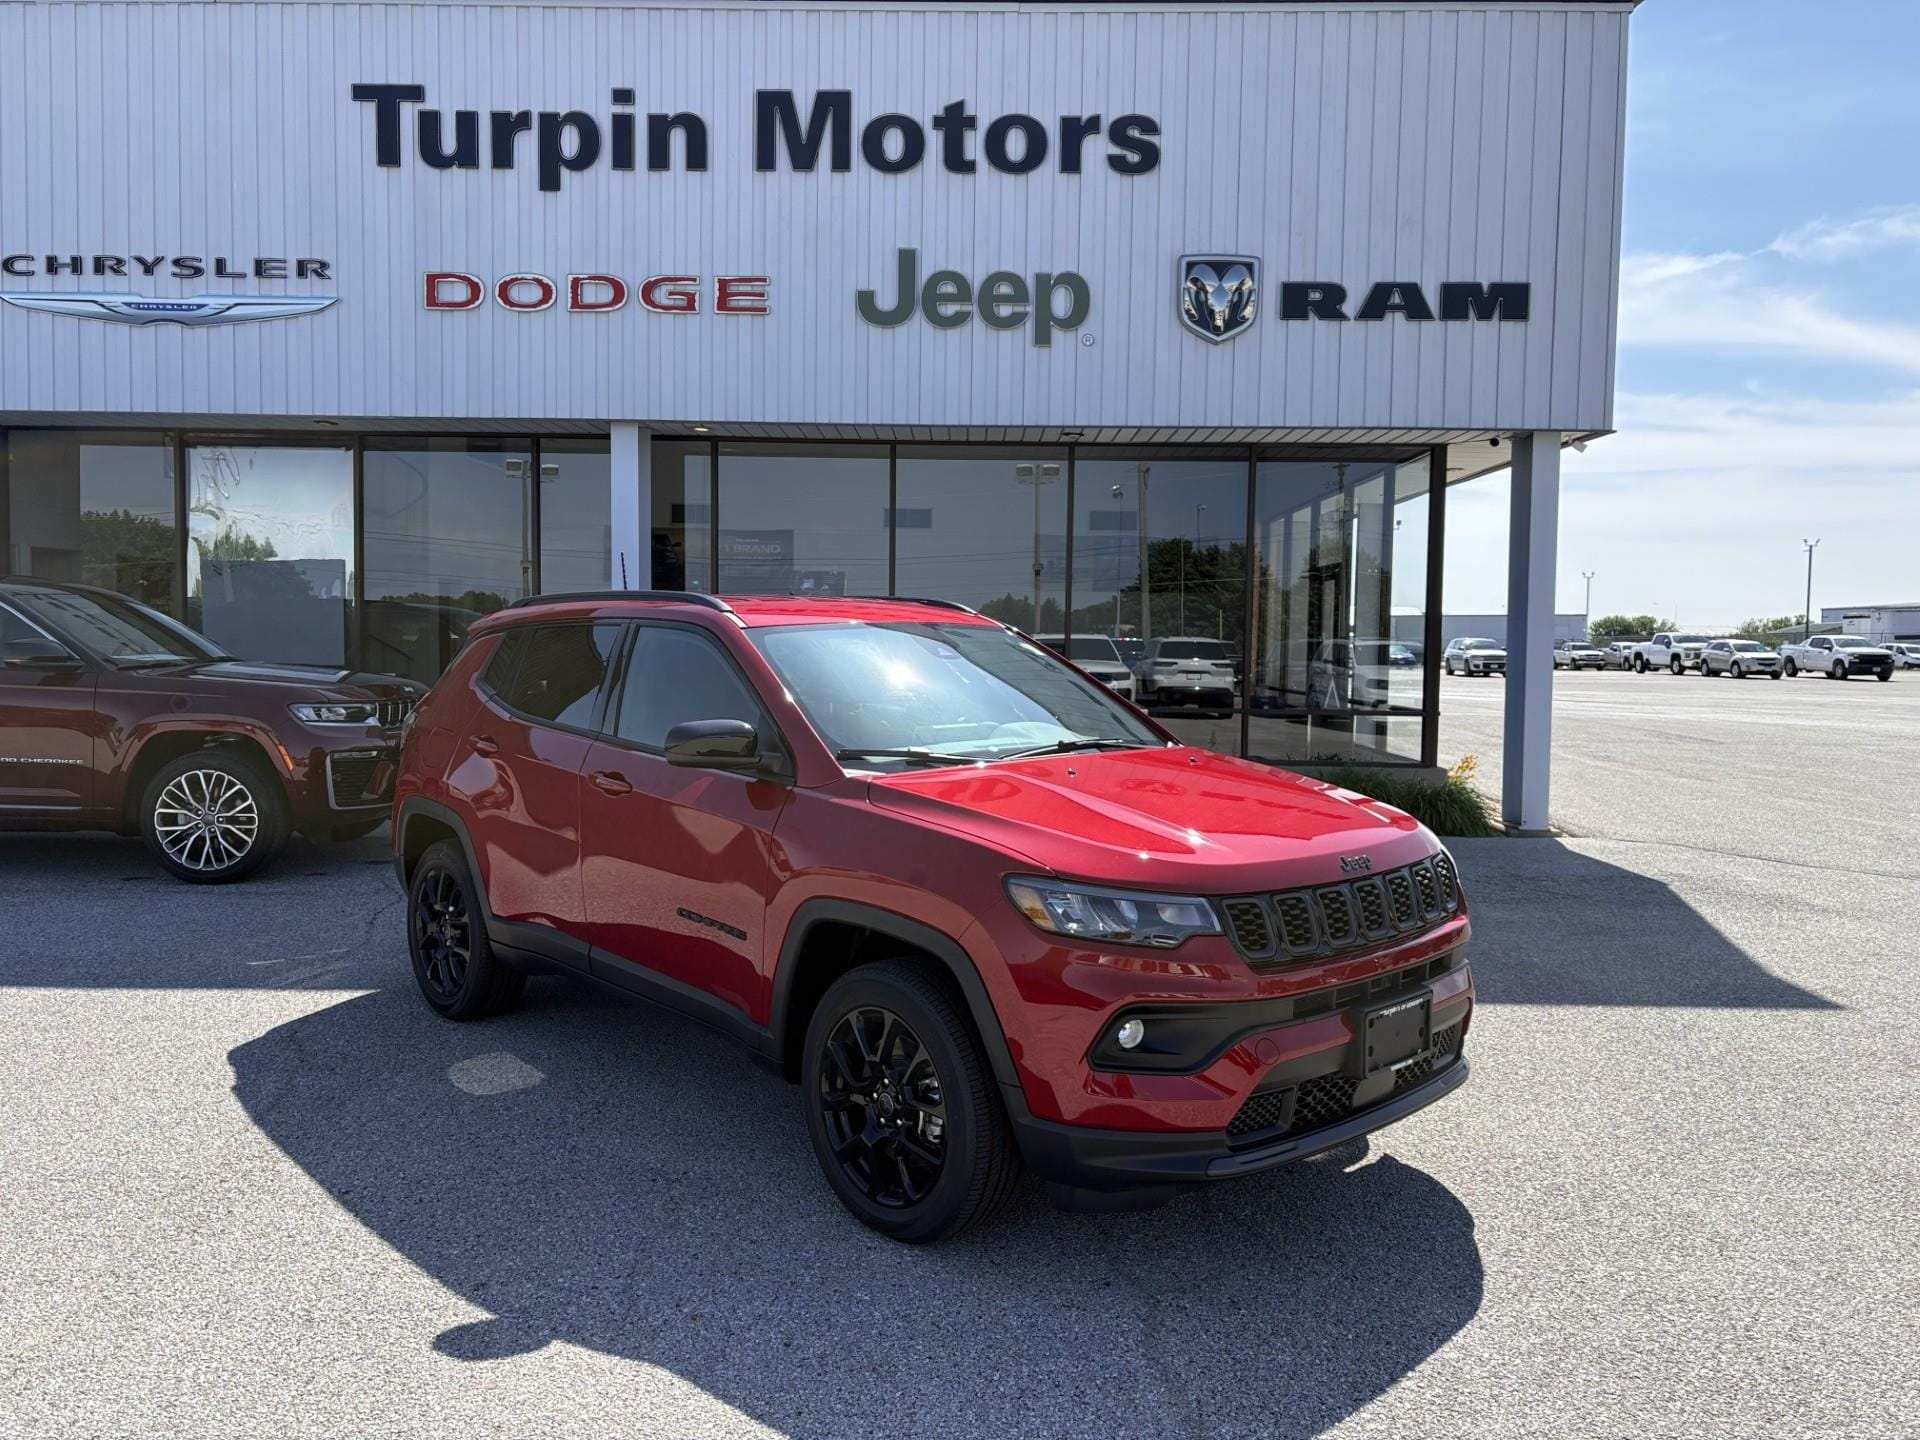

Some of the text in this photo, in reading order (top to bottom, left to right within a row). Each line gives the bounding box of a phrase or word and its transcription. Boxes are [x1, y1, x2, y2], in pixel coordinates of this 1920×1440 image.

[351, 83, 1161, 192] Turpin Motors
[2, 253, 332, 281] CHRYSLER
[424, 271, 771, 315] DODGE
[856, 247, 1091, 347] Jeep
[1280, 281, 1530, 322] RAM
[734, 544, 781, 553] BRAND
[20, 757, 84, 765] CHEROKEE
[1340, 855, 1371, 872] Jeep
